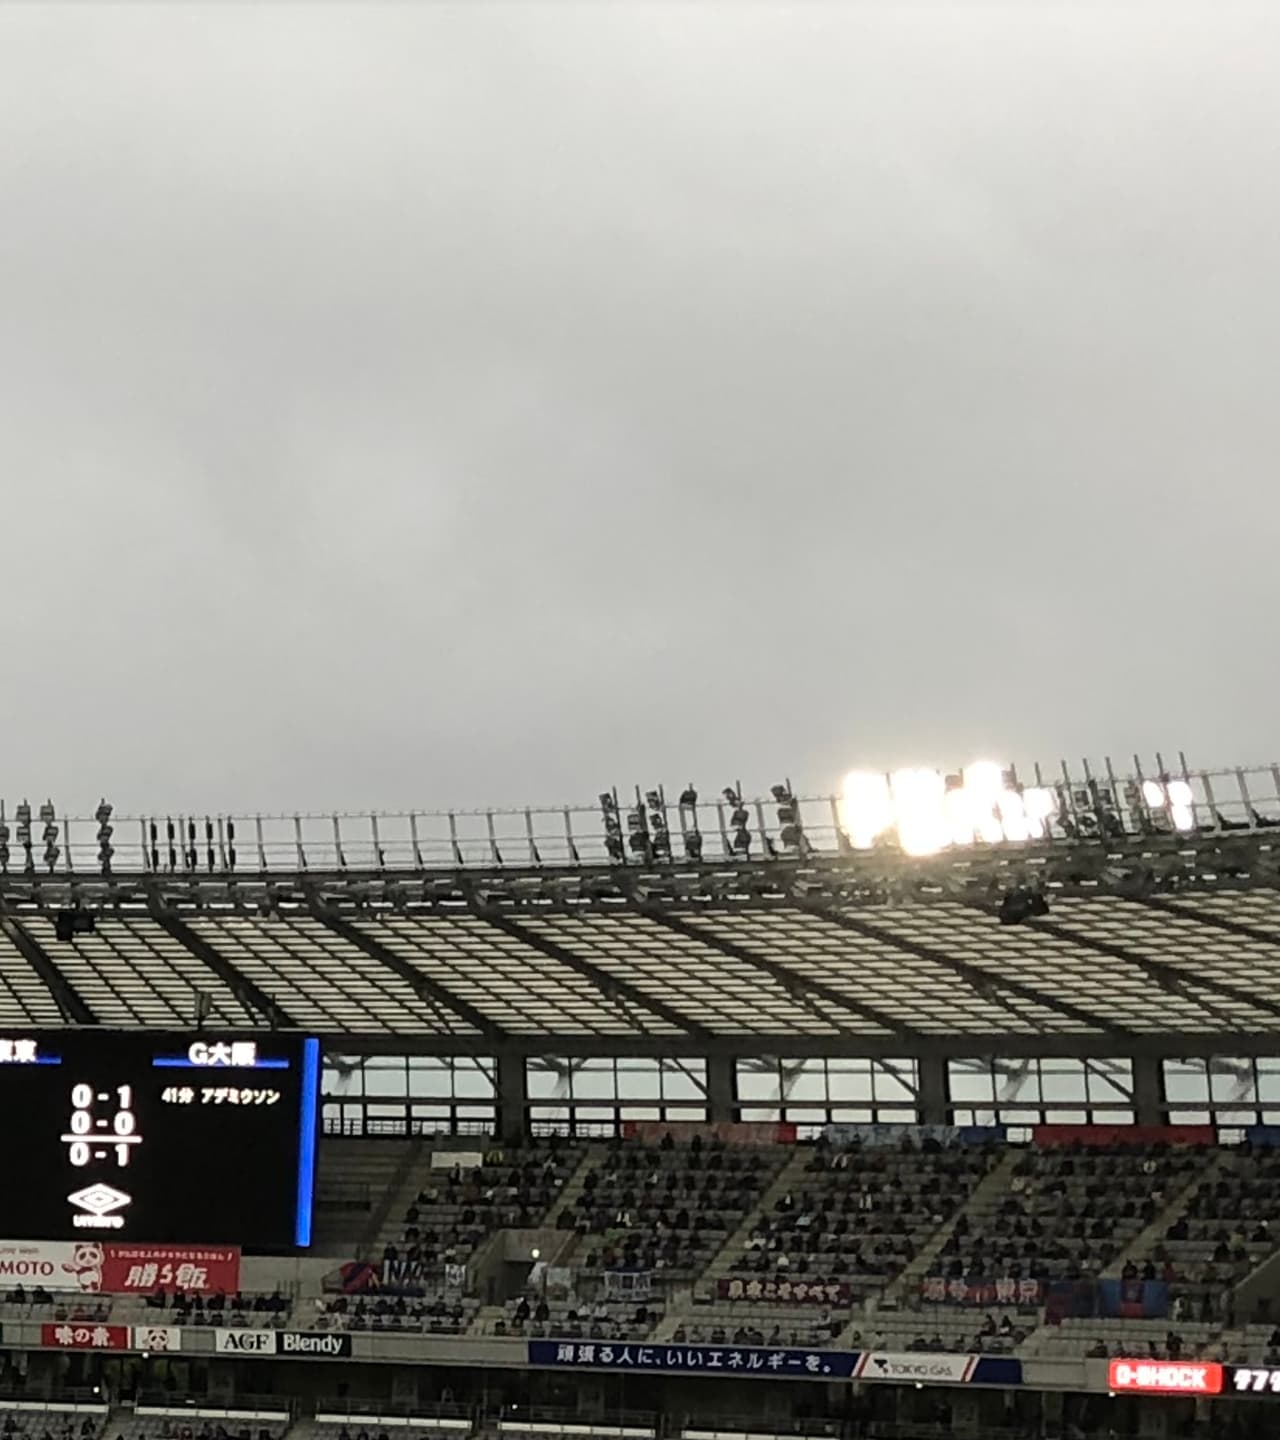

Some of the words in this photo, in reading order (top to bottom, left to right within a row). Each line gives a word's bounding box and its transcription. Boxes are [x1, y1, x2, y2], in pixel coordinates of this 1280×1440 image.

[71, 1084, 91, 1108] 0
[117, 1085, 131, 1109] 1
[71, 1110, 91, 1134] 0
[114, 1111, 134, 1135] 0
[70, 1142, 89, 1166] 0
[115, 1143, 128, 1166] 1
[55, 1326, 111, 1346] 味の素
[223, 1333, 270, 1351] AGF
[282, 1333, 343, 1356] Blendy
[557, 1347, 832, 1374] 頑張る人に、いいエネルギーを。
[891, 1362, 926, 1375] TOKYO
[929, 1364, 953, 1377] GAS
[1115, 1363, 1207, 1388] G-SHOCK
